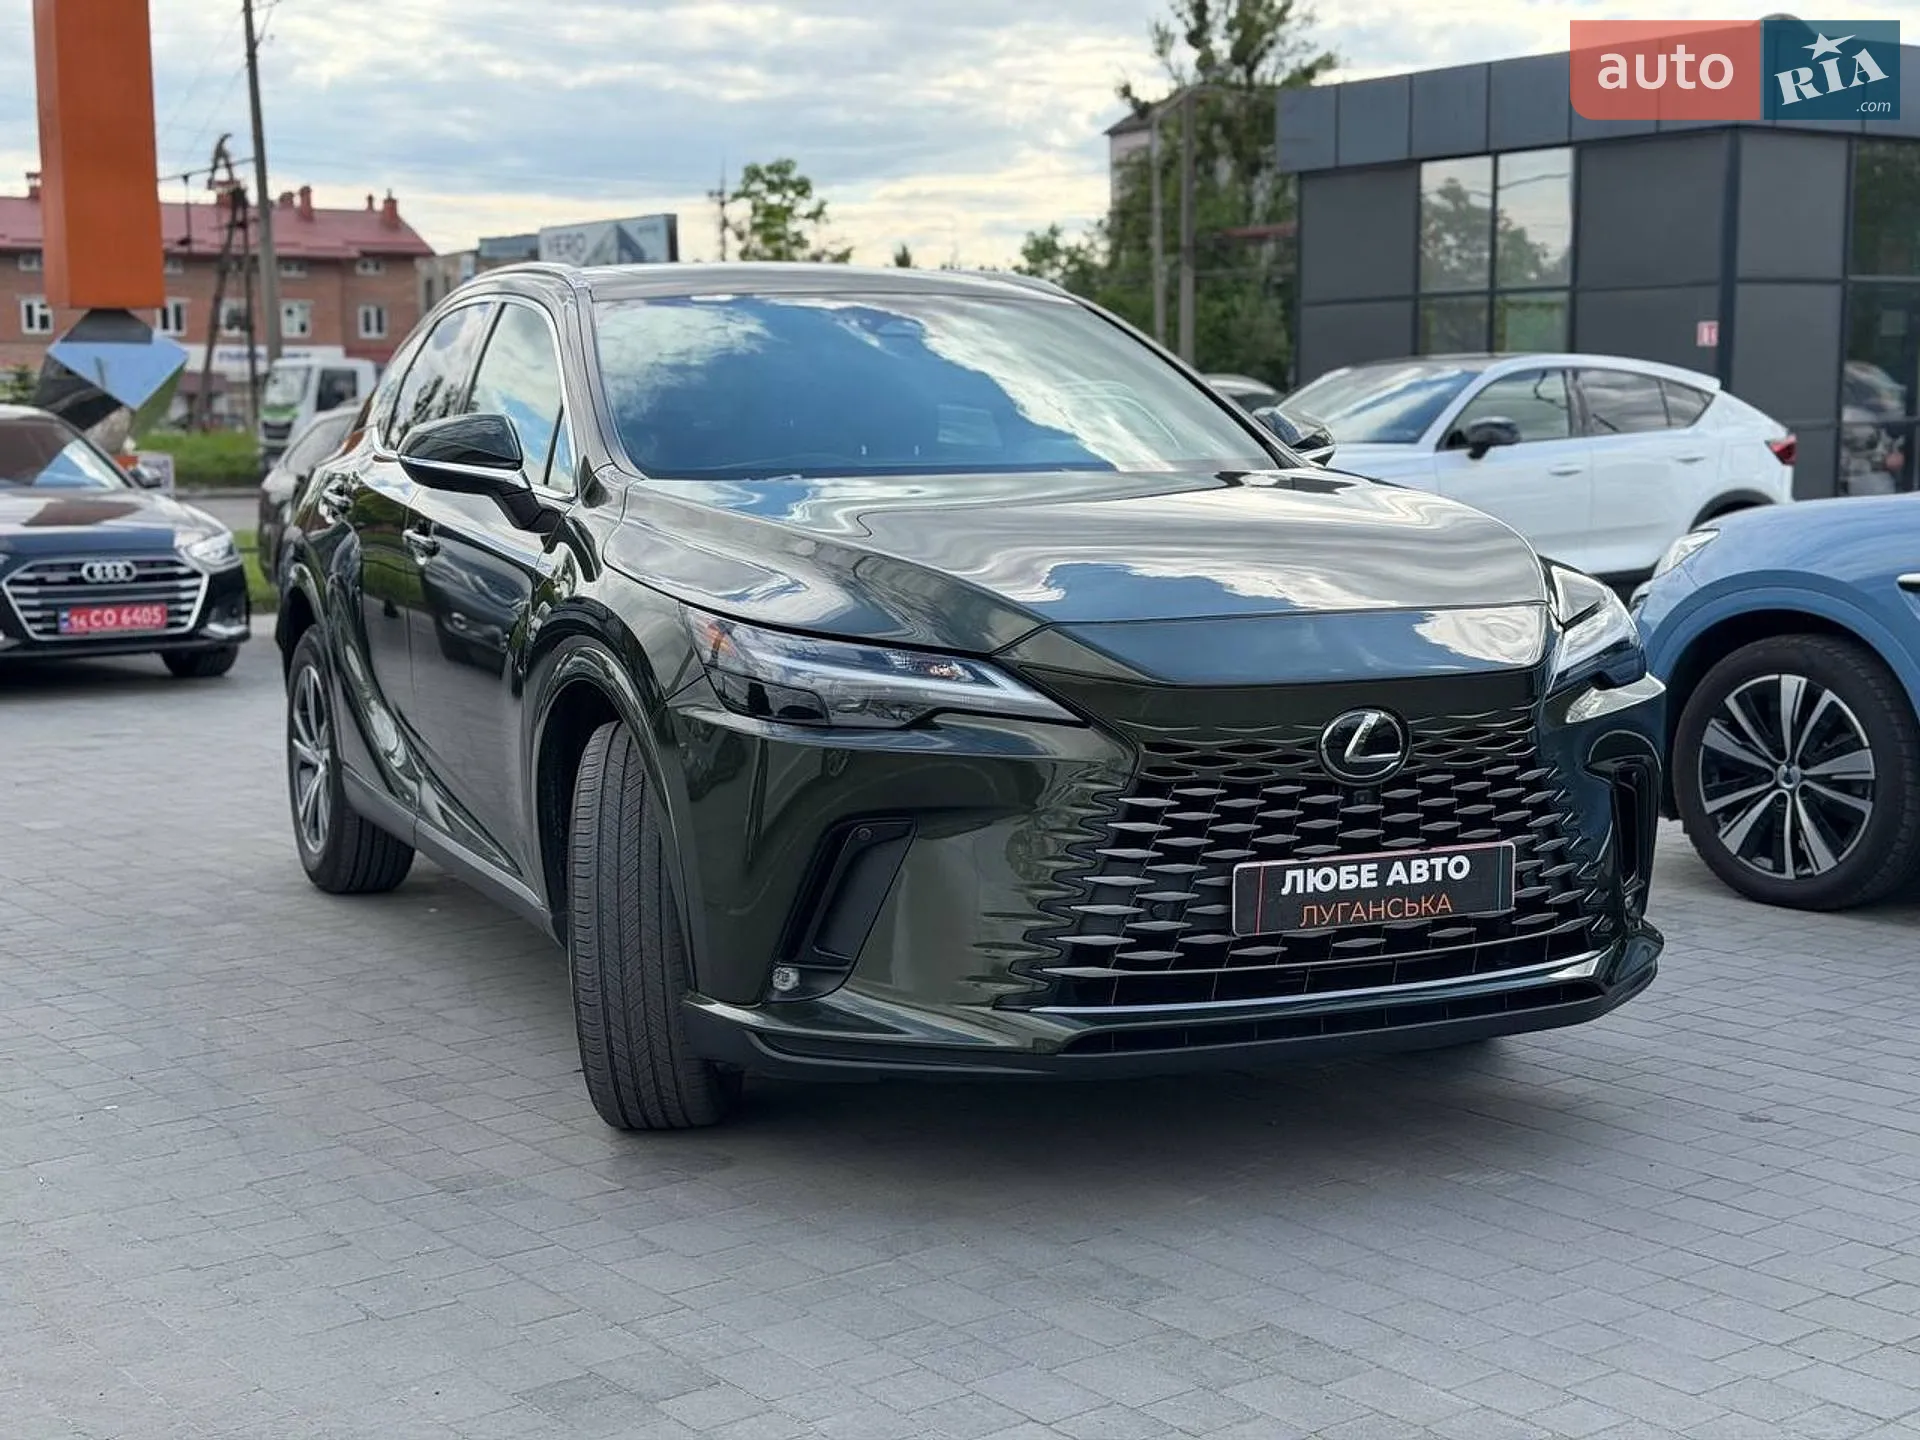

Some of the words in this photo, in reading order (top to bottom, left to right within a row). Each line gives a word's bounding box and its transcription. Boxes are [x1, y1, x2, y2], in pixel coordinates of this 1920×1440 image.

[1281, 863, 1378, 896] ЛЮБЕ
[1386, 855, 1471, 887] АВТО
[1299, 893, 1453, 928] ЛУГАНСЬКА
